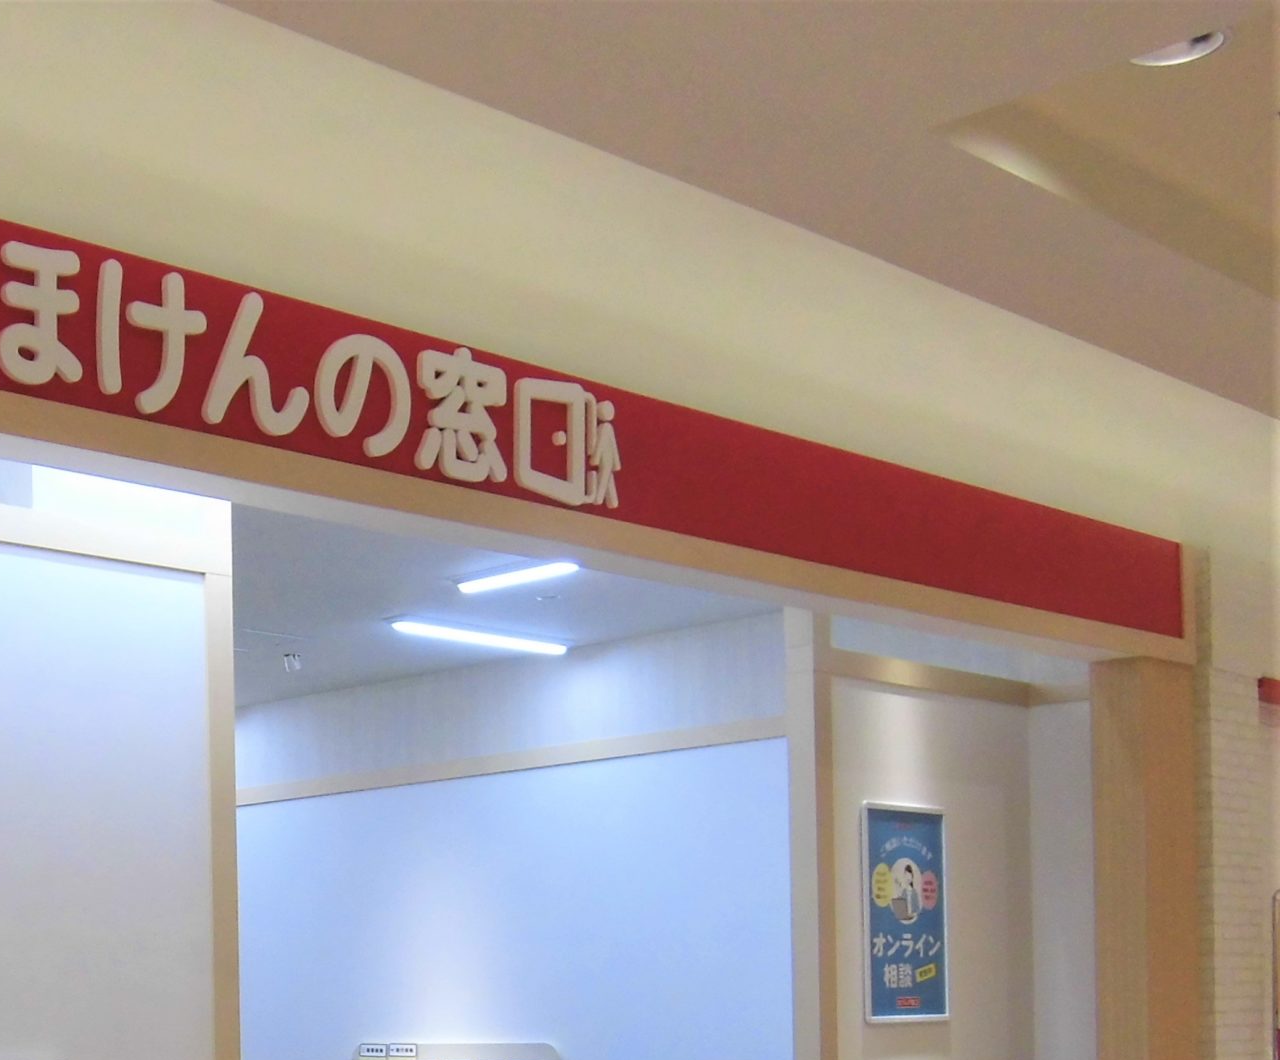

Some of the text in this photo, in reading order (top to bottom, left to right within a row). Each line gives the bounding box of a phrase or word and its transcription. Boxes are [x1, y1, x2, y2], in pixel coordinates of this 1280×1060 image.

[872, 932, 942, 958] オンライン
[883, 963, 913, 989] 相談
